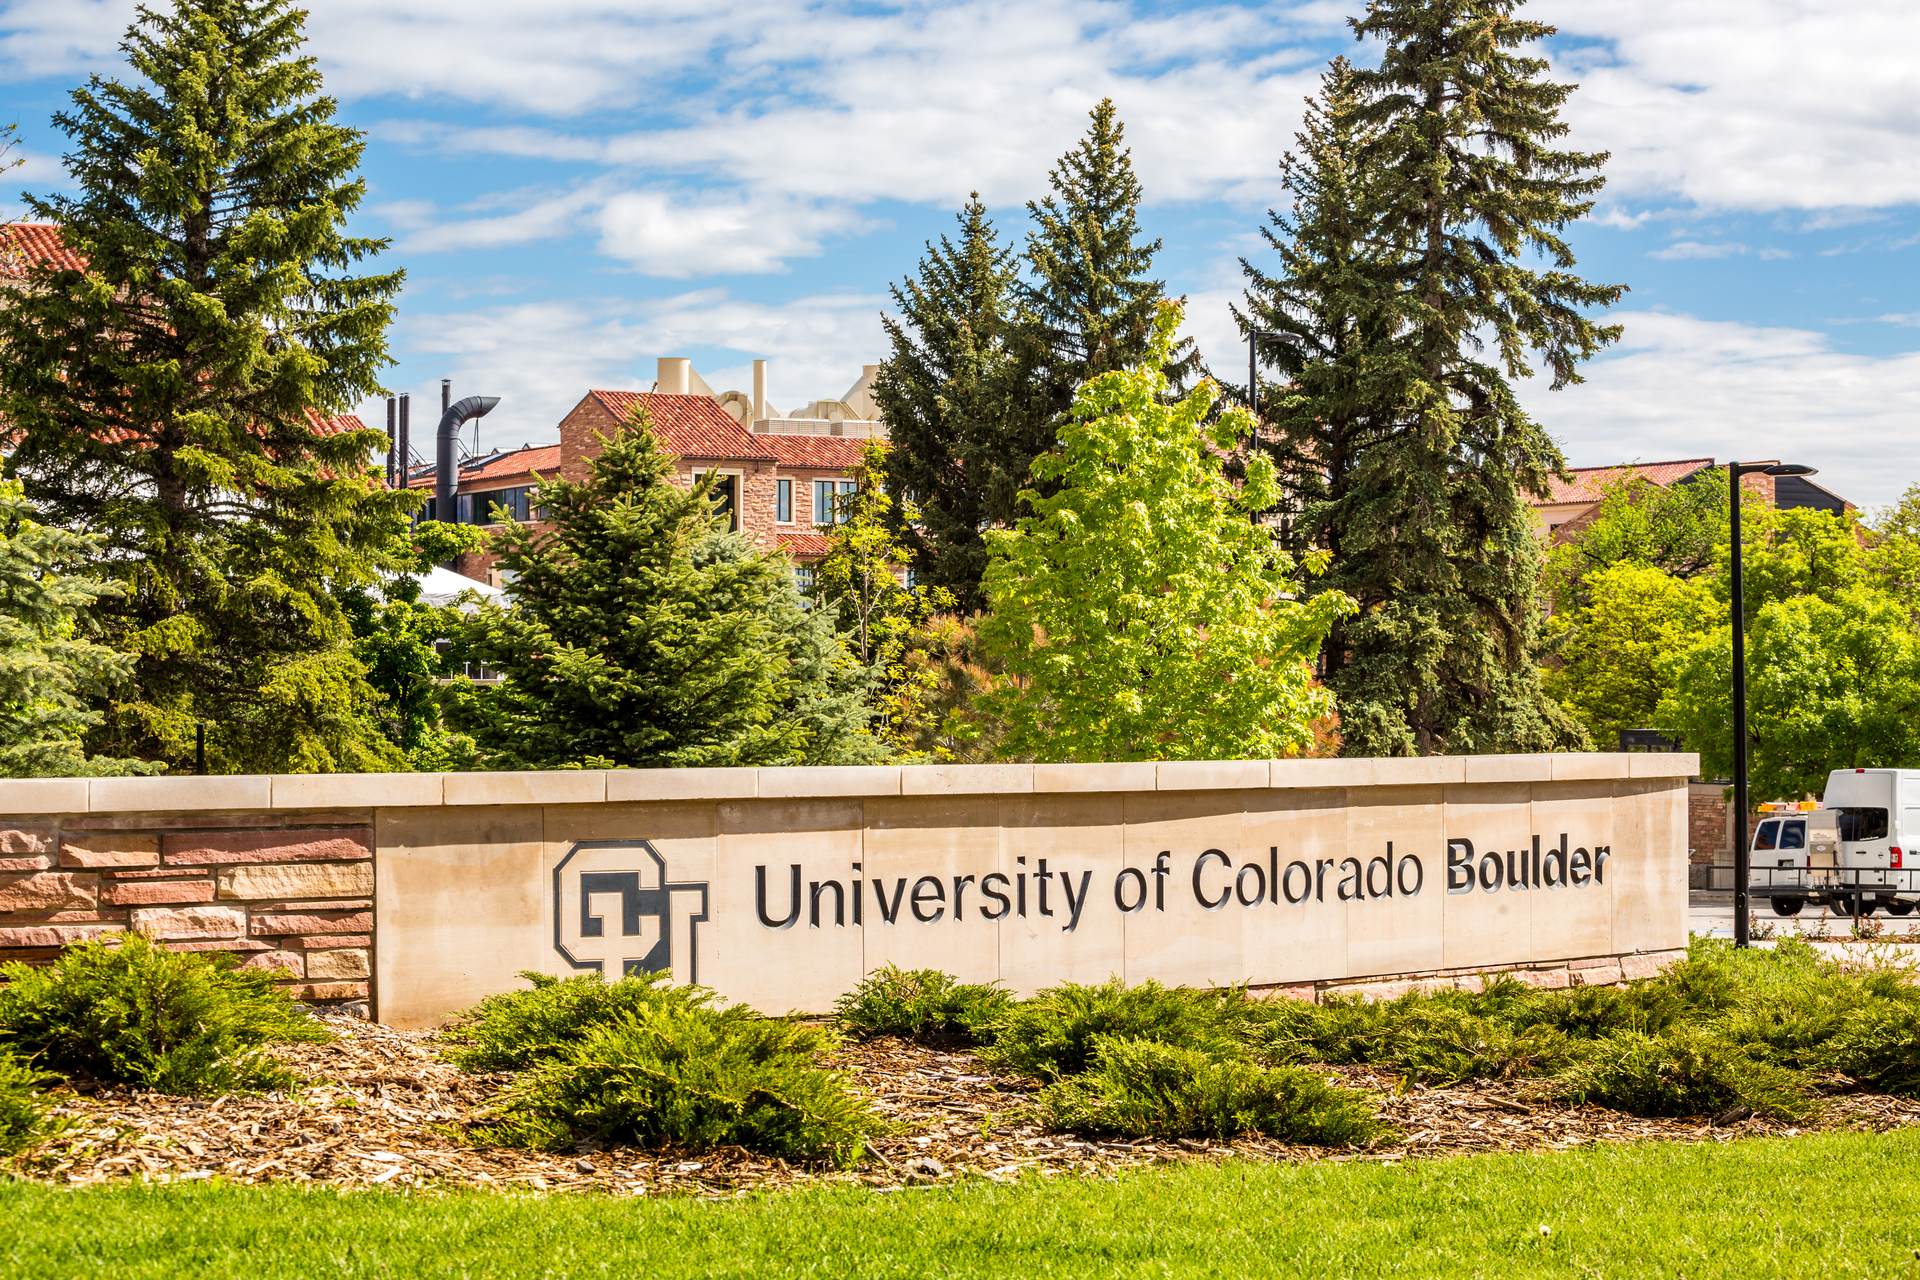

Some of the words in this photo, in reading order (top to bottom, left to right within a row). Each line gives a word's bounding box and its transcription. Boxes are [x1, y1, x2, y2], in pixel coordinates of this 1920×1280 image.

[754, 856, 1093, 934] University
[1113, 850, 1171, 914] of
[1191, 841, 1424, 912] Colorado
[1447, 832, 1611, 895] Boulder
